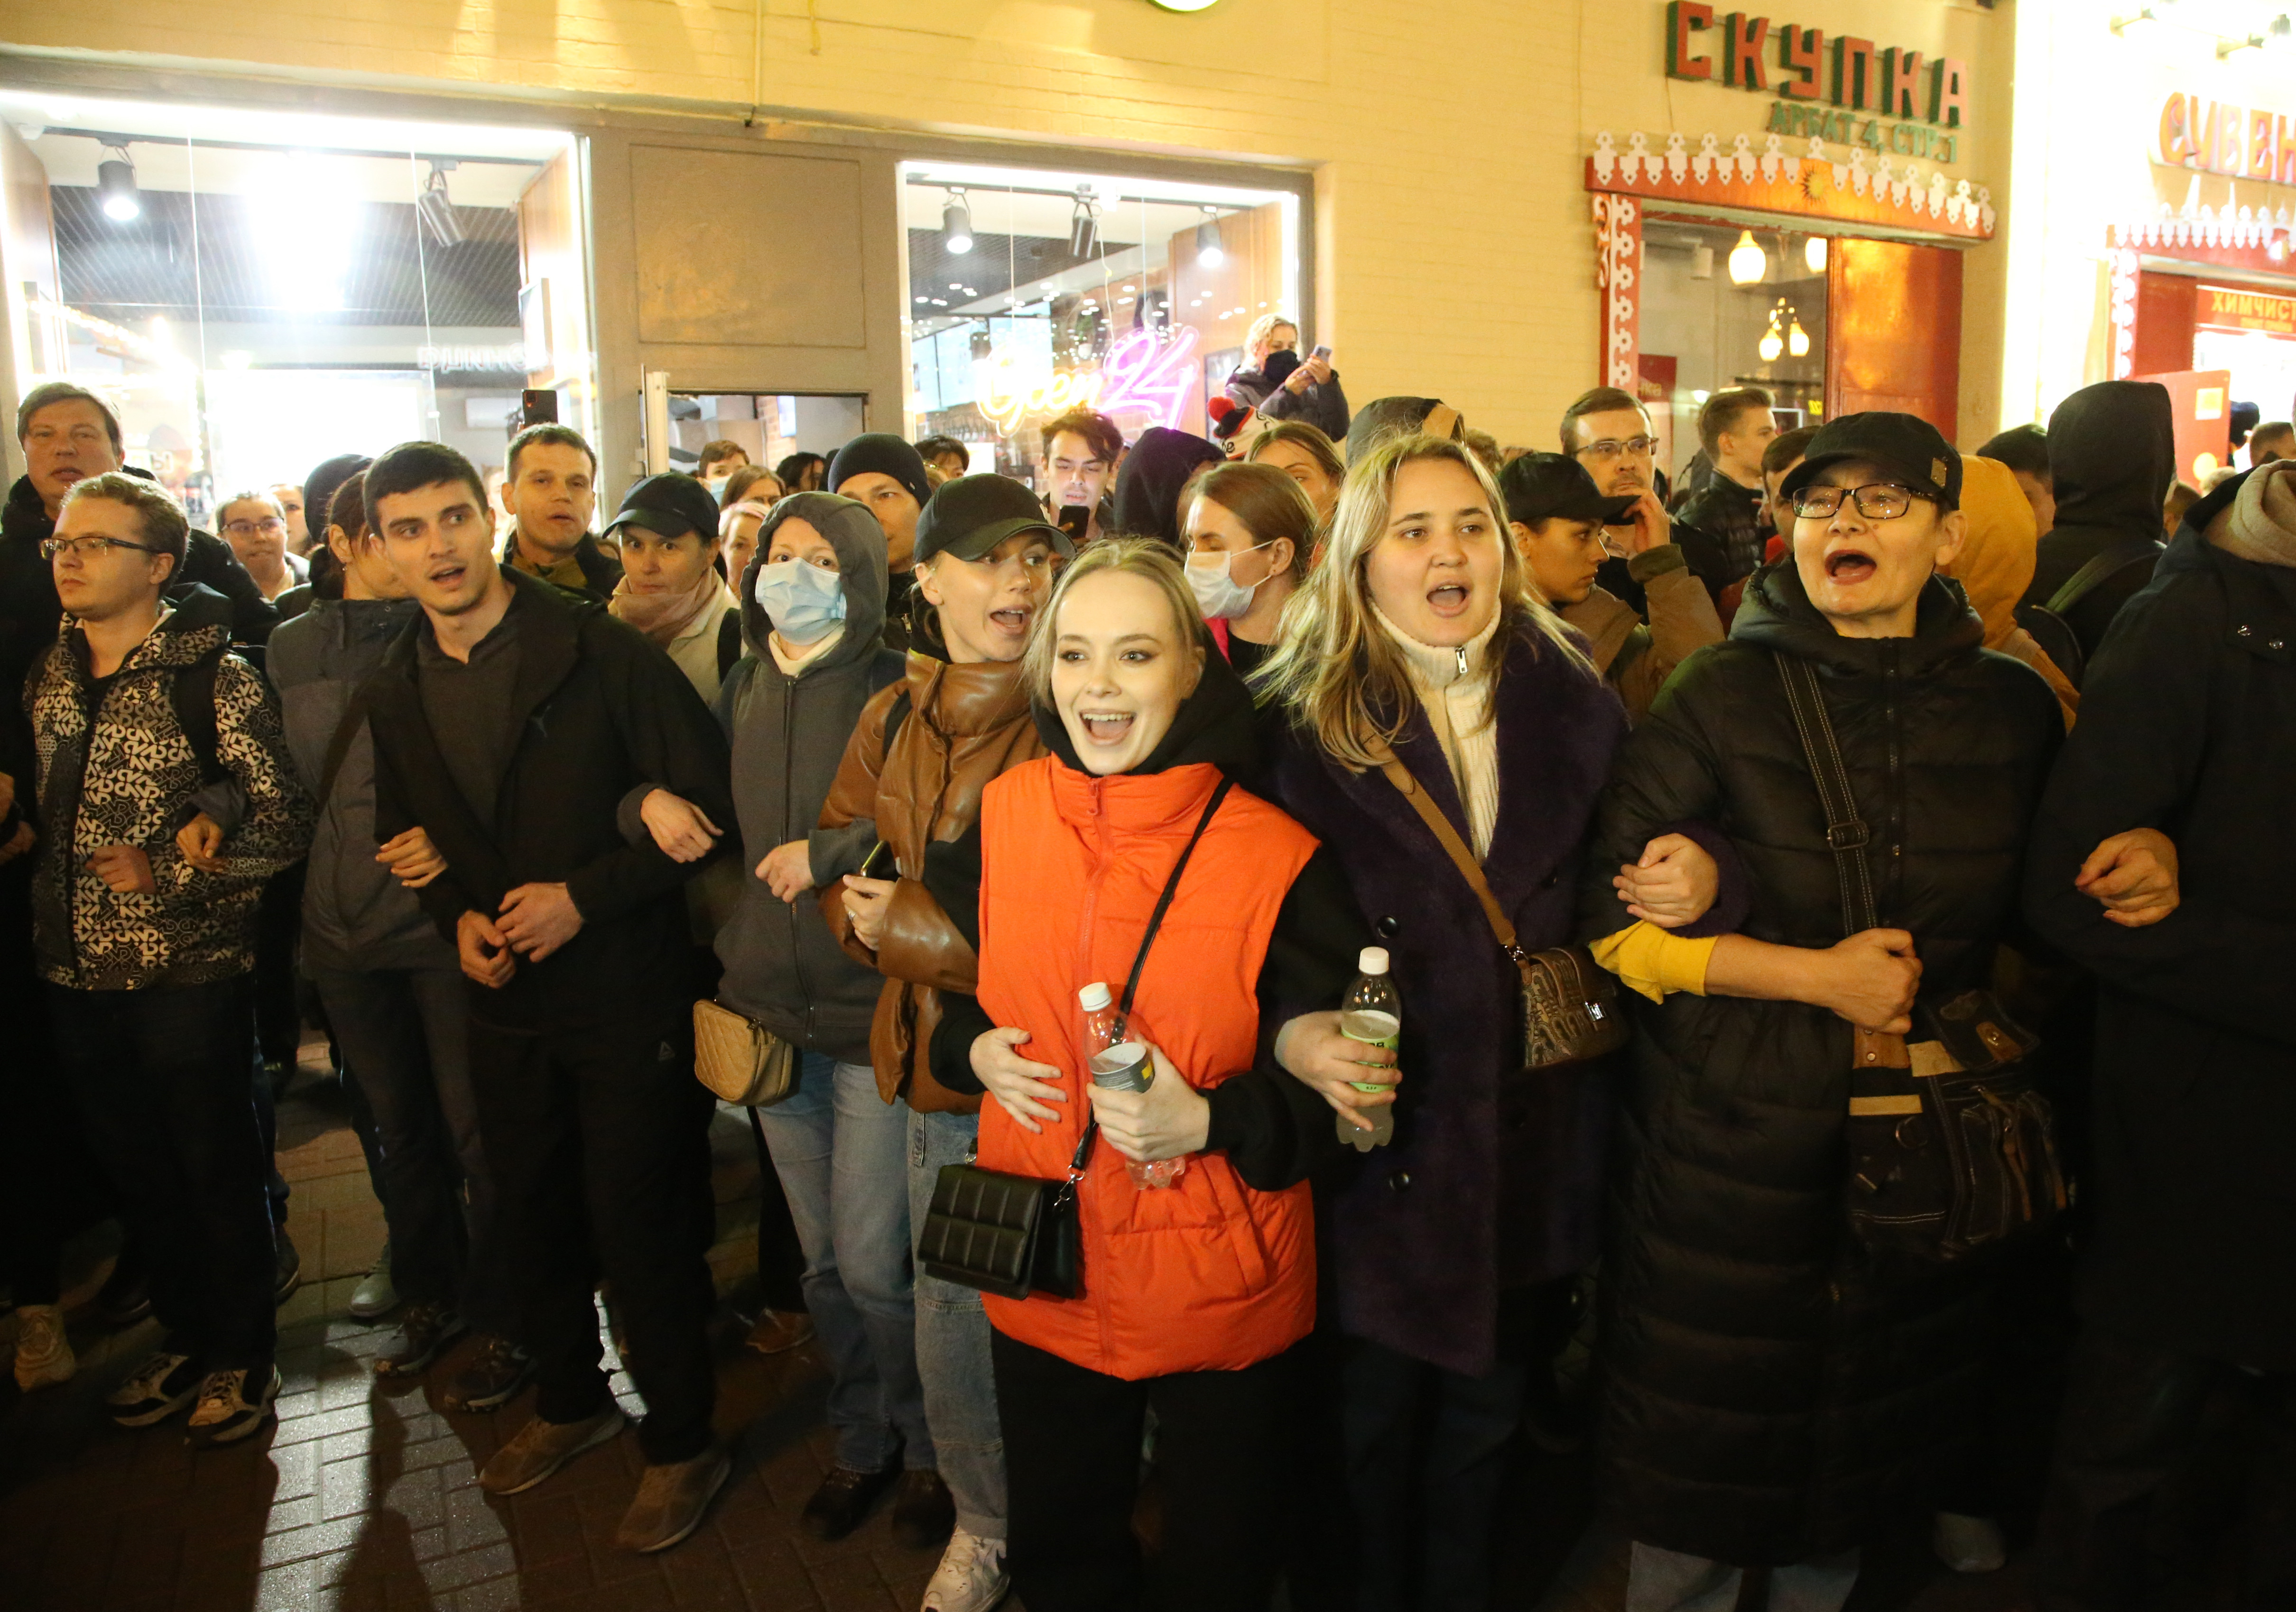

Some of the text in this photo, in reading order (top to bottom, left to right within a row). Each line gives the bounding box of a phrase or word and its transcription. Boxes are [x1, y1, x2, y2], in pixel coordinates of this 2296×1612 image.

[1666, 0, 1970, 128] СКУПКА
[1766, 100, 1856, 145] АРБАТ
[1862, 119, 1884, 156] 4,
[1098, 331, 1195, 430] 24
